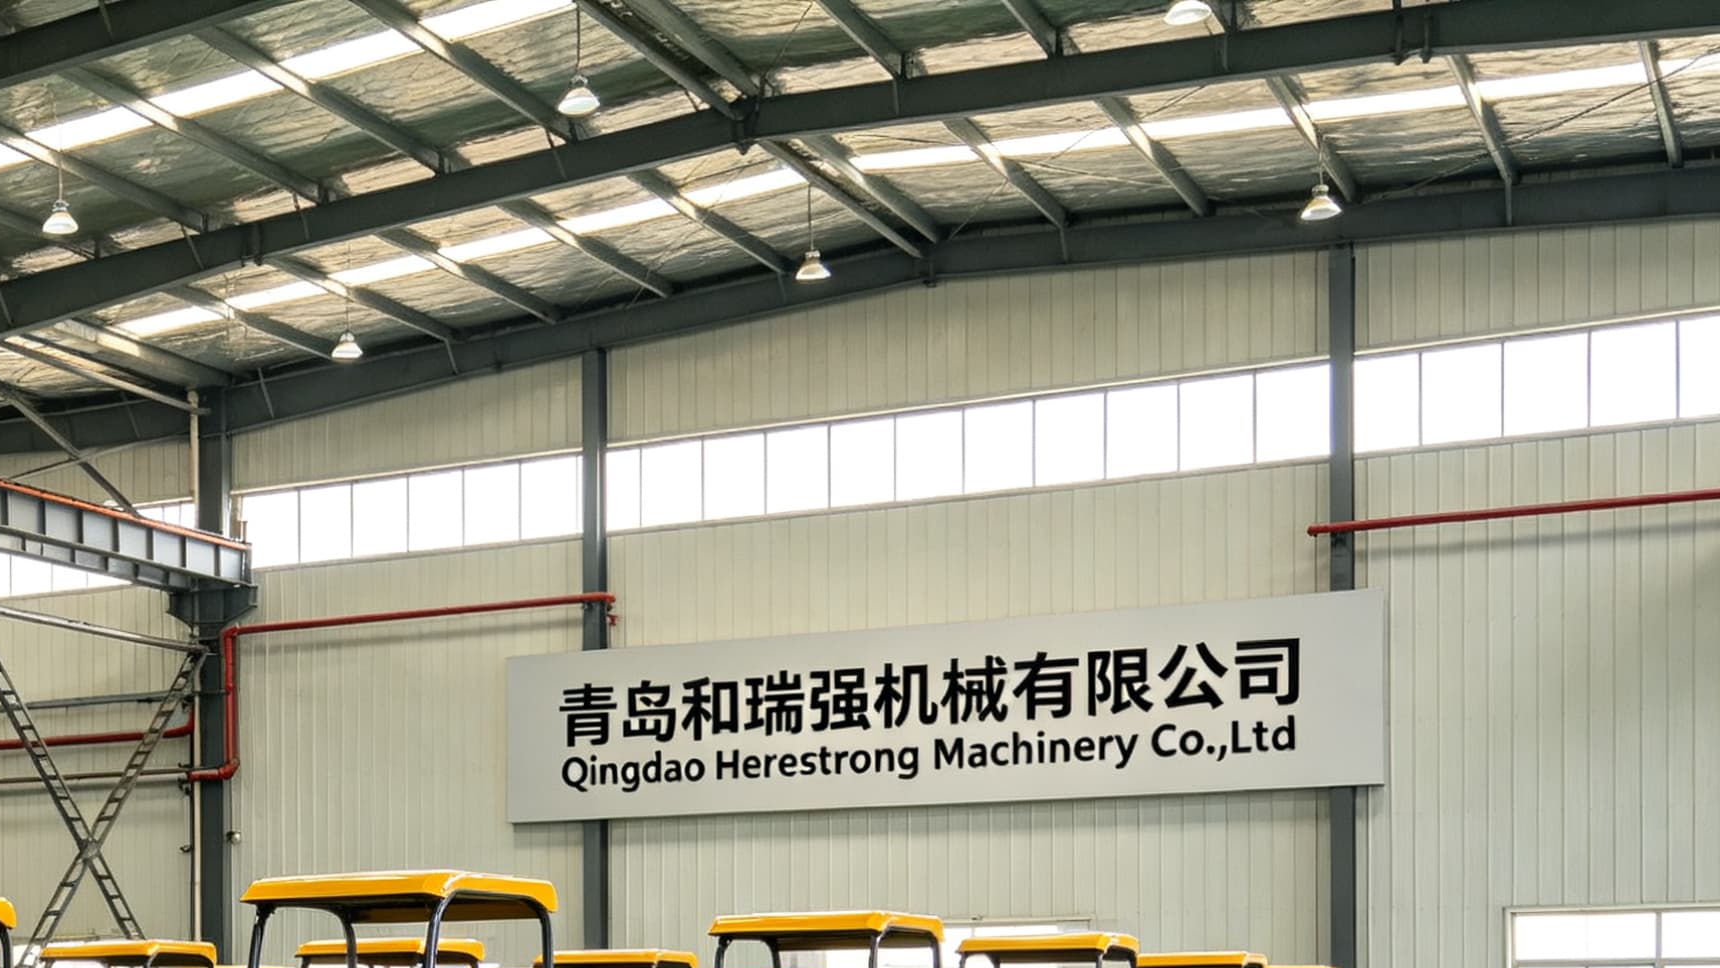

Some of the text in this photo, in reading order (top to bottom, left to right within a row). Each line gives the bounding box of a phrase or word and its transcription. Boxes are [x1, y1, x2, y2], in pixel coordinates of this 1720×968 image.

[558, 637, 1301, 748] 青岛和瑞强机械有限公司
[561, 714, 1296, 793] Qingdao Herestrong Machinery Co.,Ltd
